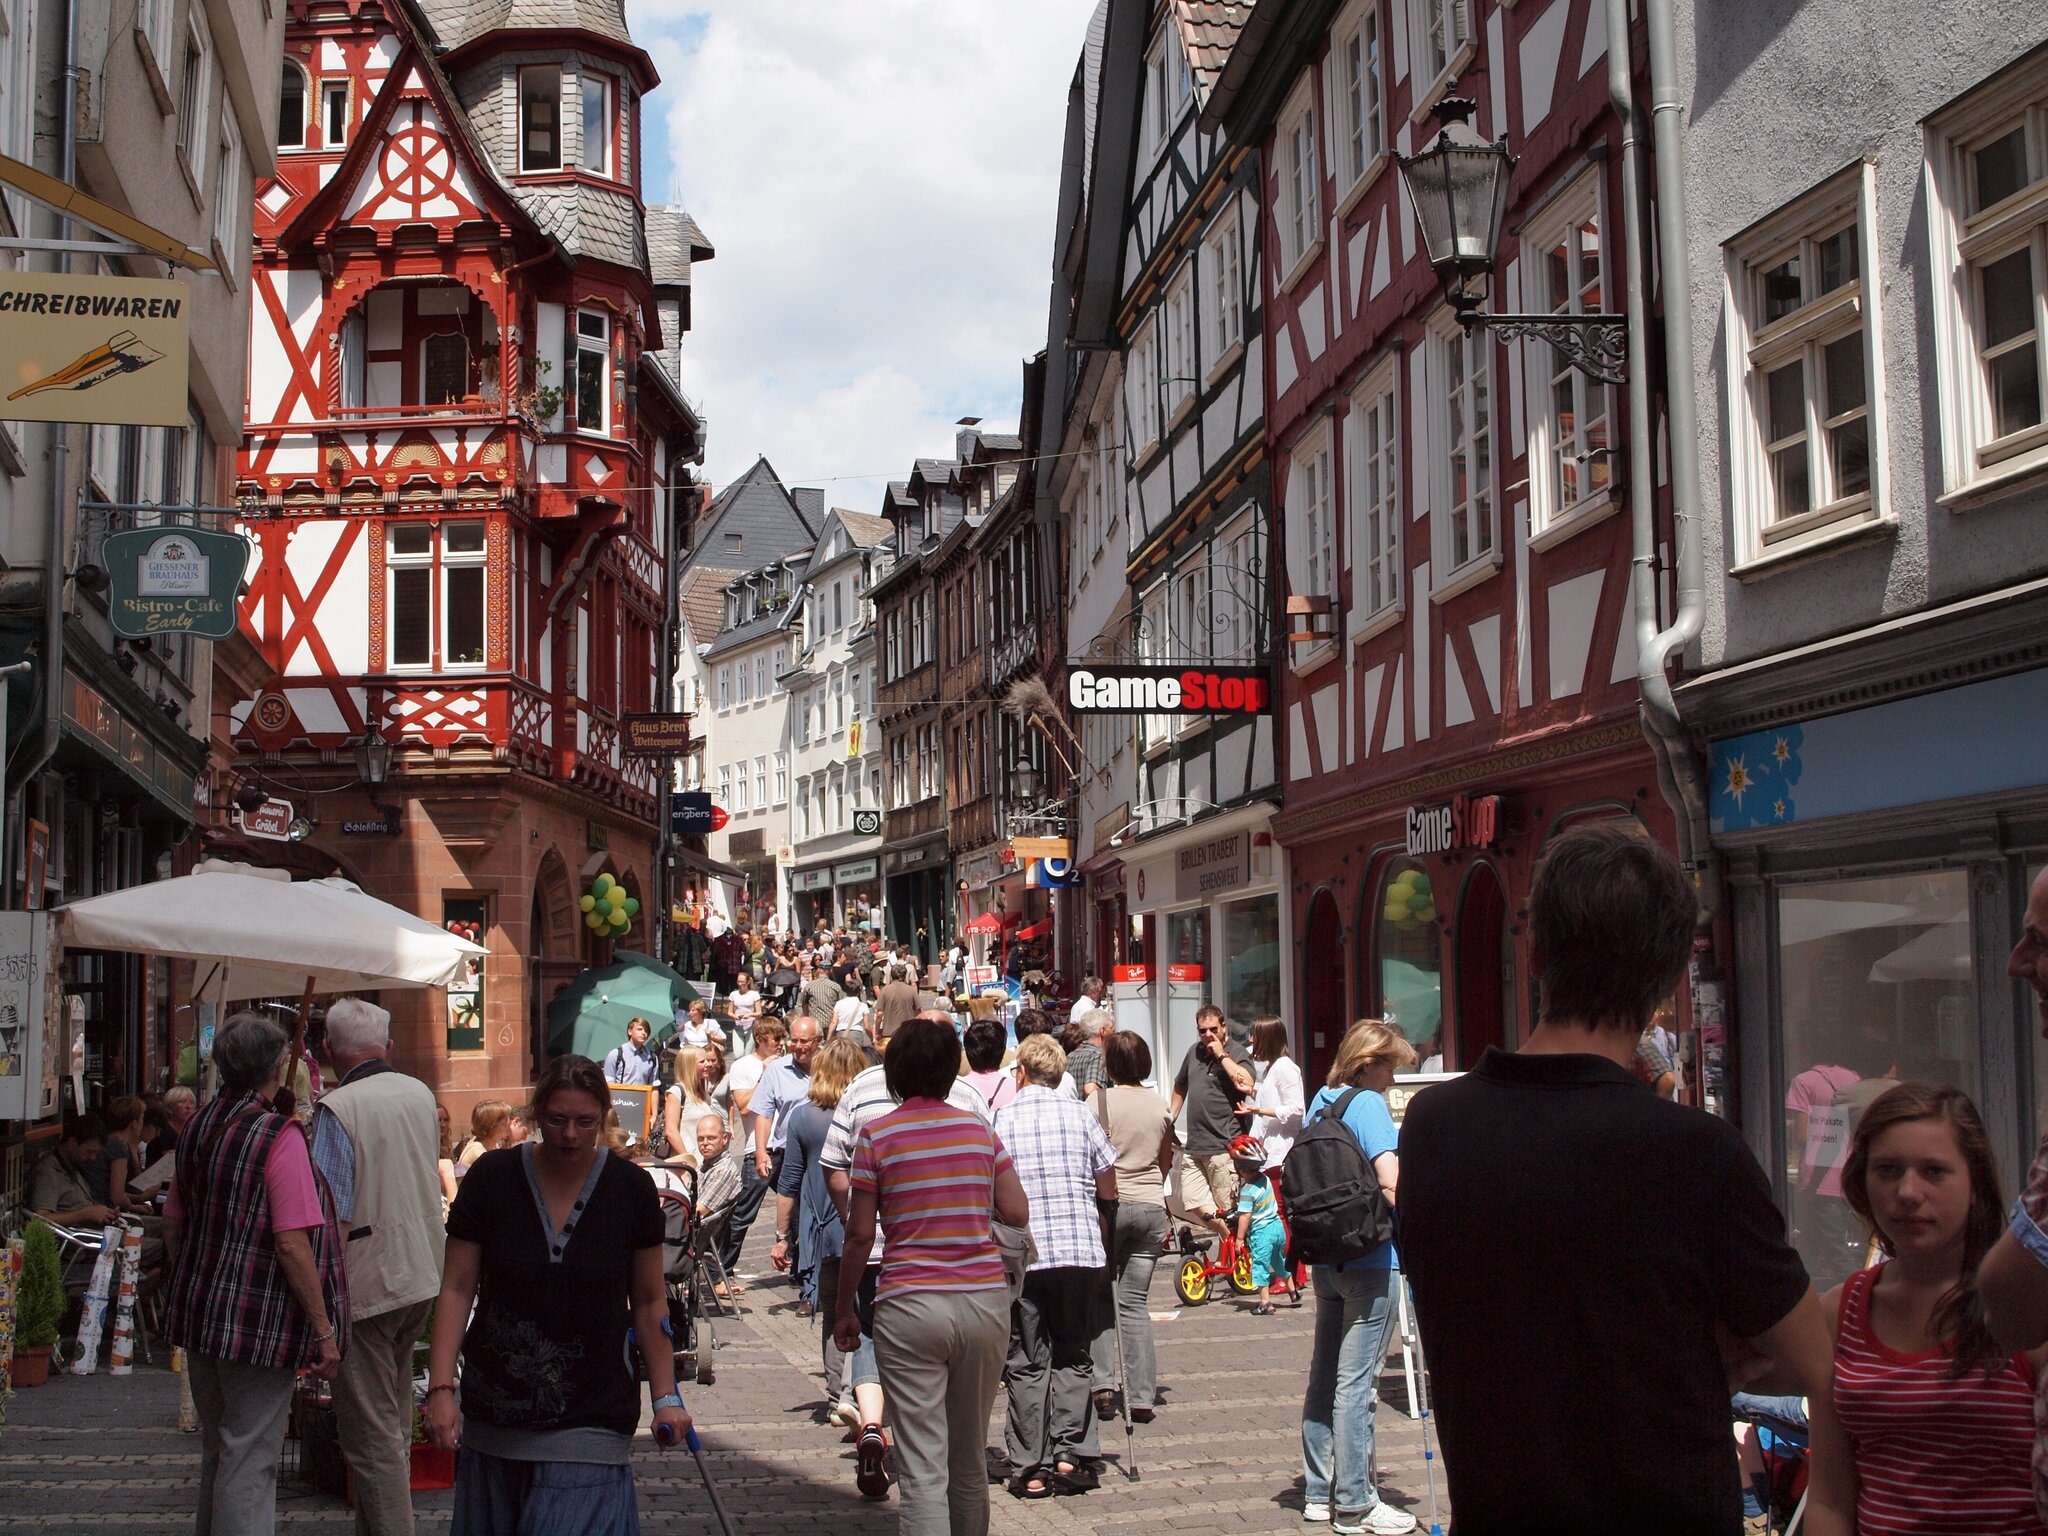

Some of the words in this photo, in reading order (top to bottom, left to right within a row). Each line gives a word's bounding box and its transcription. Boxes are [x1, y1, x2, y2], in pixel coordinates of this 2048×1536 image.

[148, 562, 199, 571] GIESSENER
[149, 571, 199, 580] BRAUHAUS
[1069, 670, 1268, 712] GameStop
[631, 720, 659, 737] Haus
[633, 736, 683, 748] Wettergasse
[672, 810, 710, 820] engbers
[255, 818, 279, 833] Gröbel
[1406, 794, 1497, 857] GameStop
[1181, 844, 1207, 870] BRILLEN
[1208, 836, 1239, 862] TRABERT
[1200, 866, 1239, 891] SEHENSWERT
